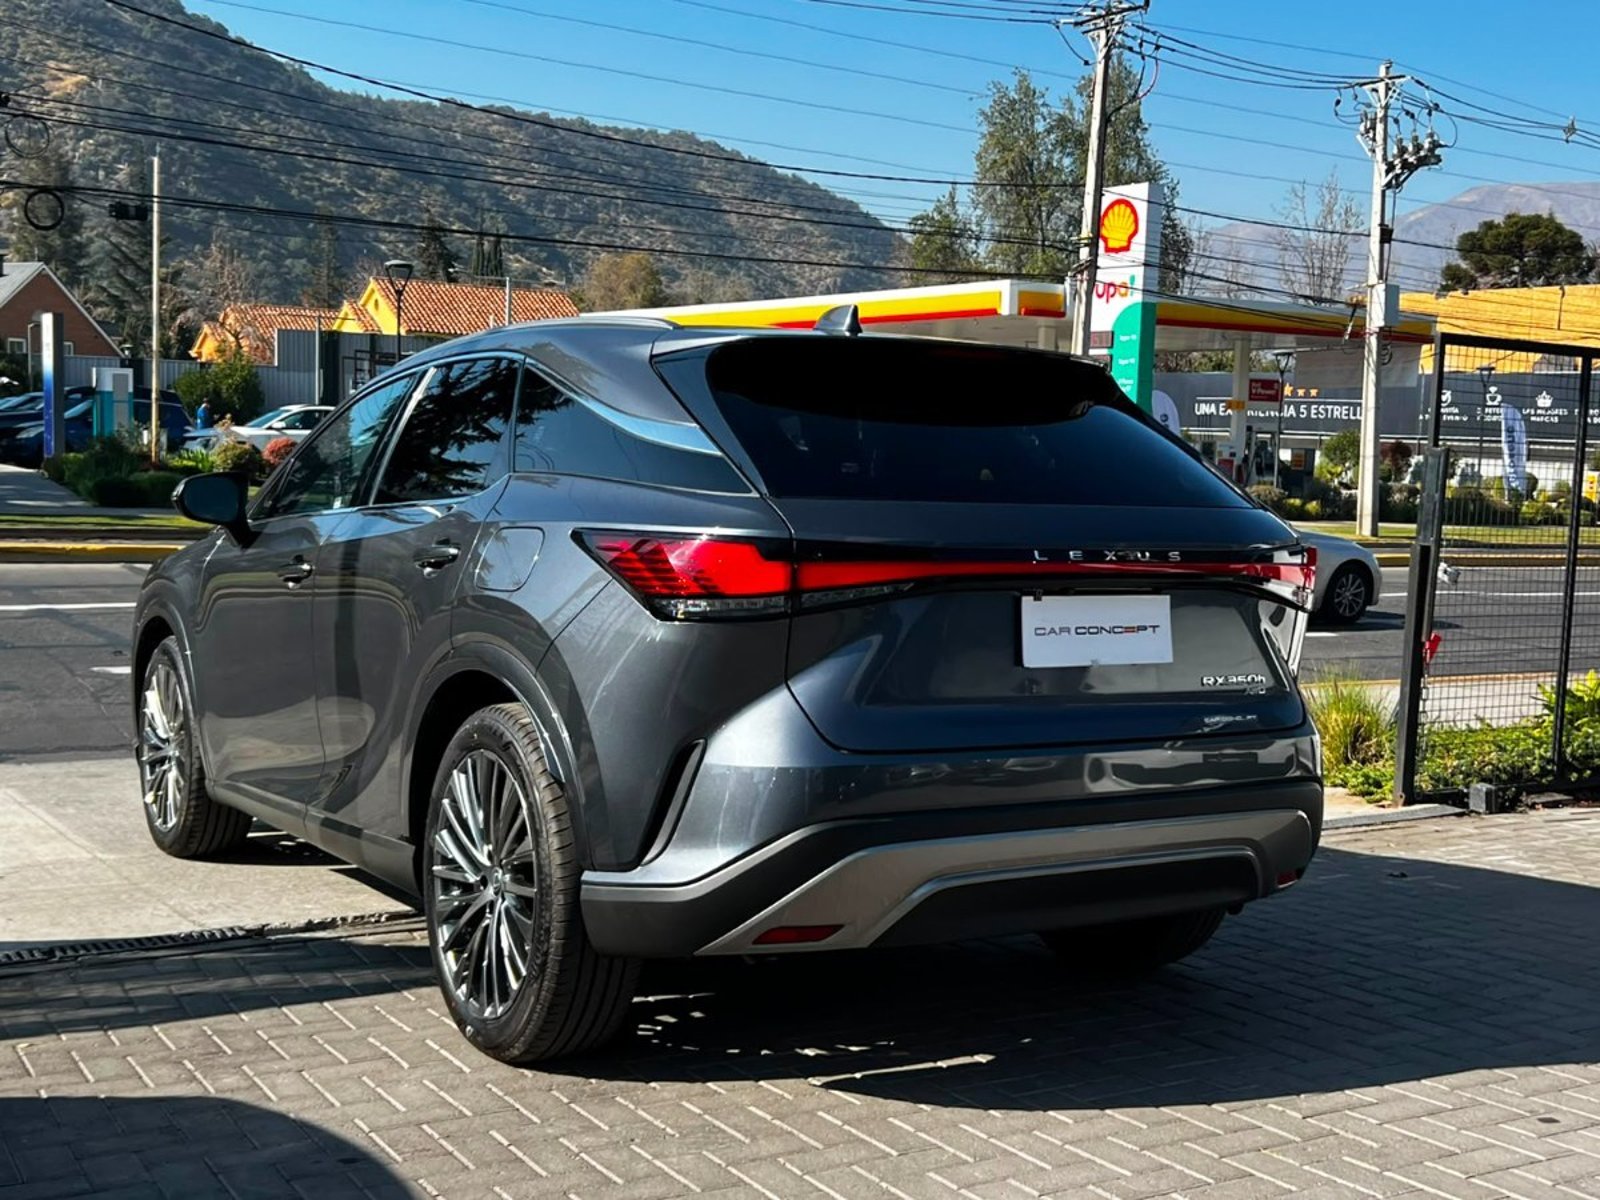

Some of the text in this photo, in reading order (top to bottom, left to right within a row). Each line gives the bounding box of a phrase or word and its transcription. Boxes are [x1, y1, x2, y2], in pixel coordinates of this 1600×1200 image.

[1194, 402, 1217, 416] UNA
[1299, 404, 1308, 419] 5
[1310, 404, 1363, 420] ESTRELL
[1033, 549, 1182, 562] LEXUS
[1034, 624, 1161, 637] CAR CONCEPT
